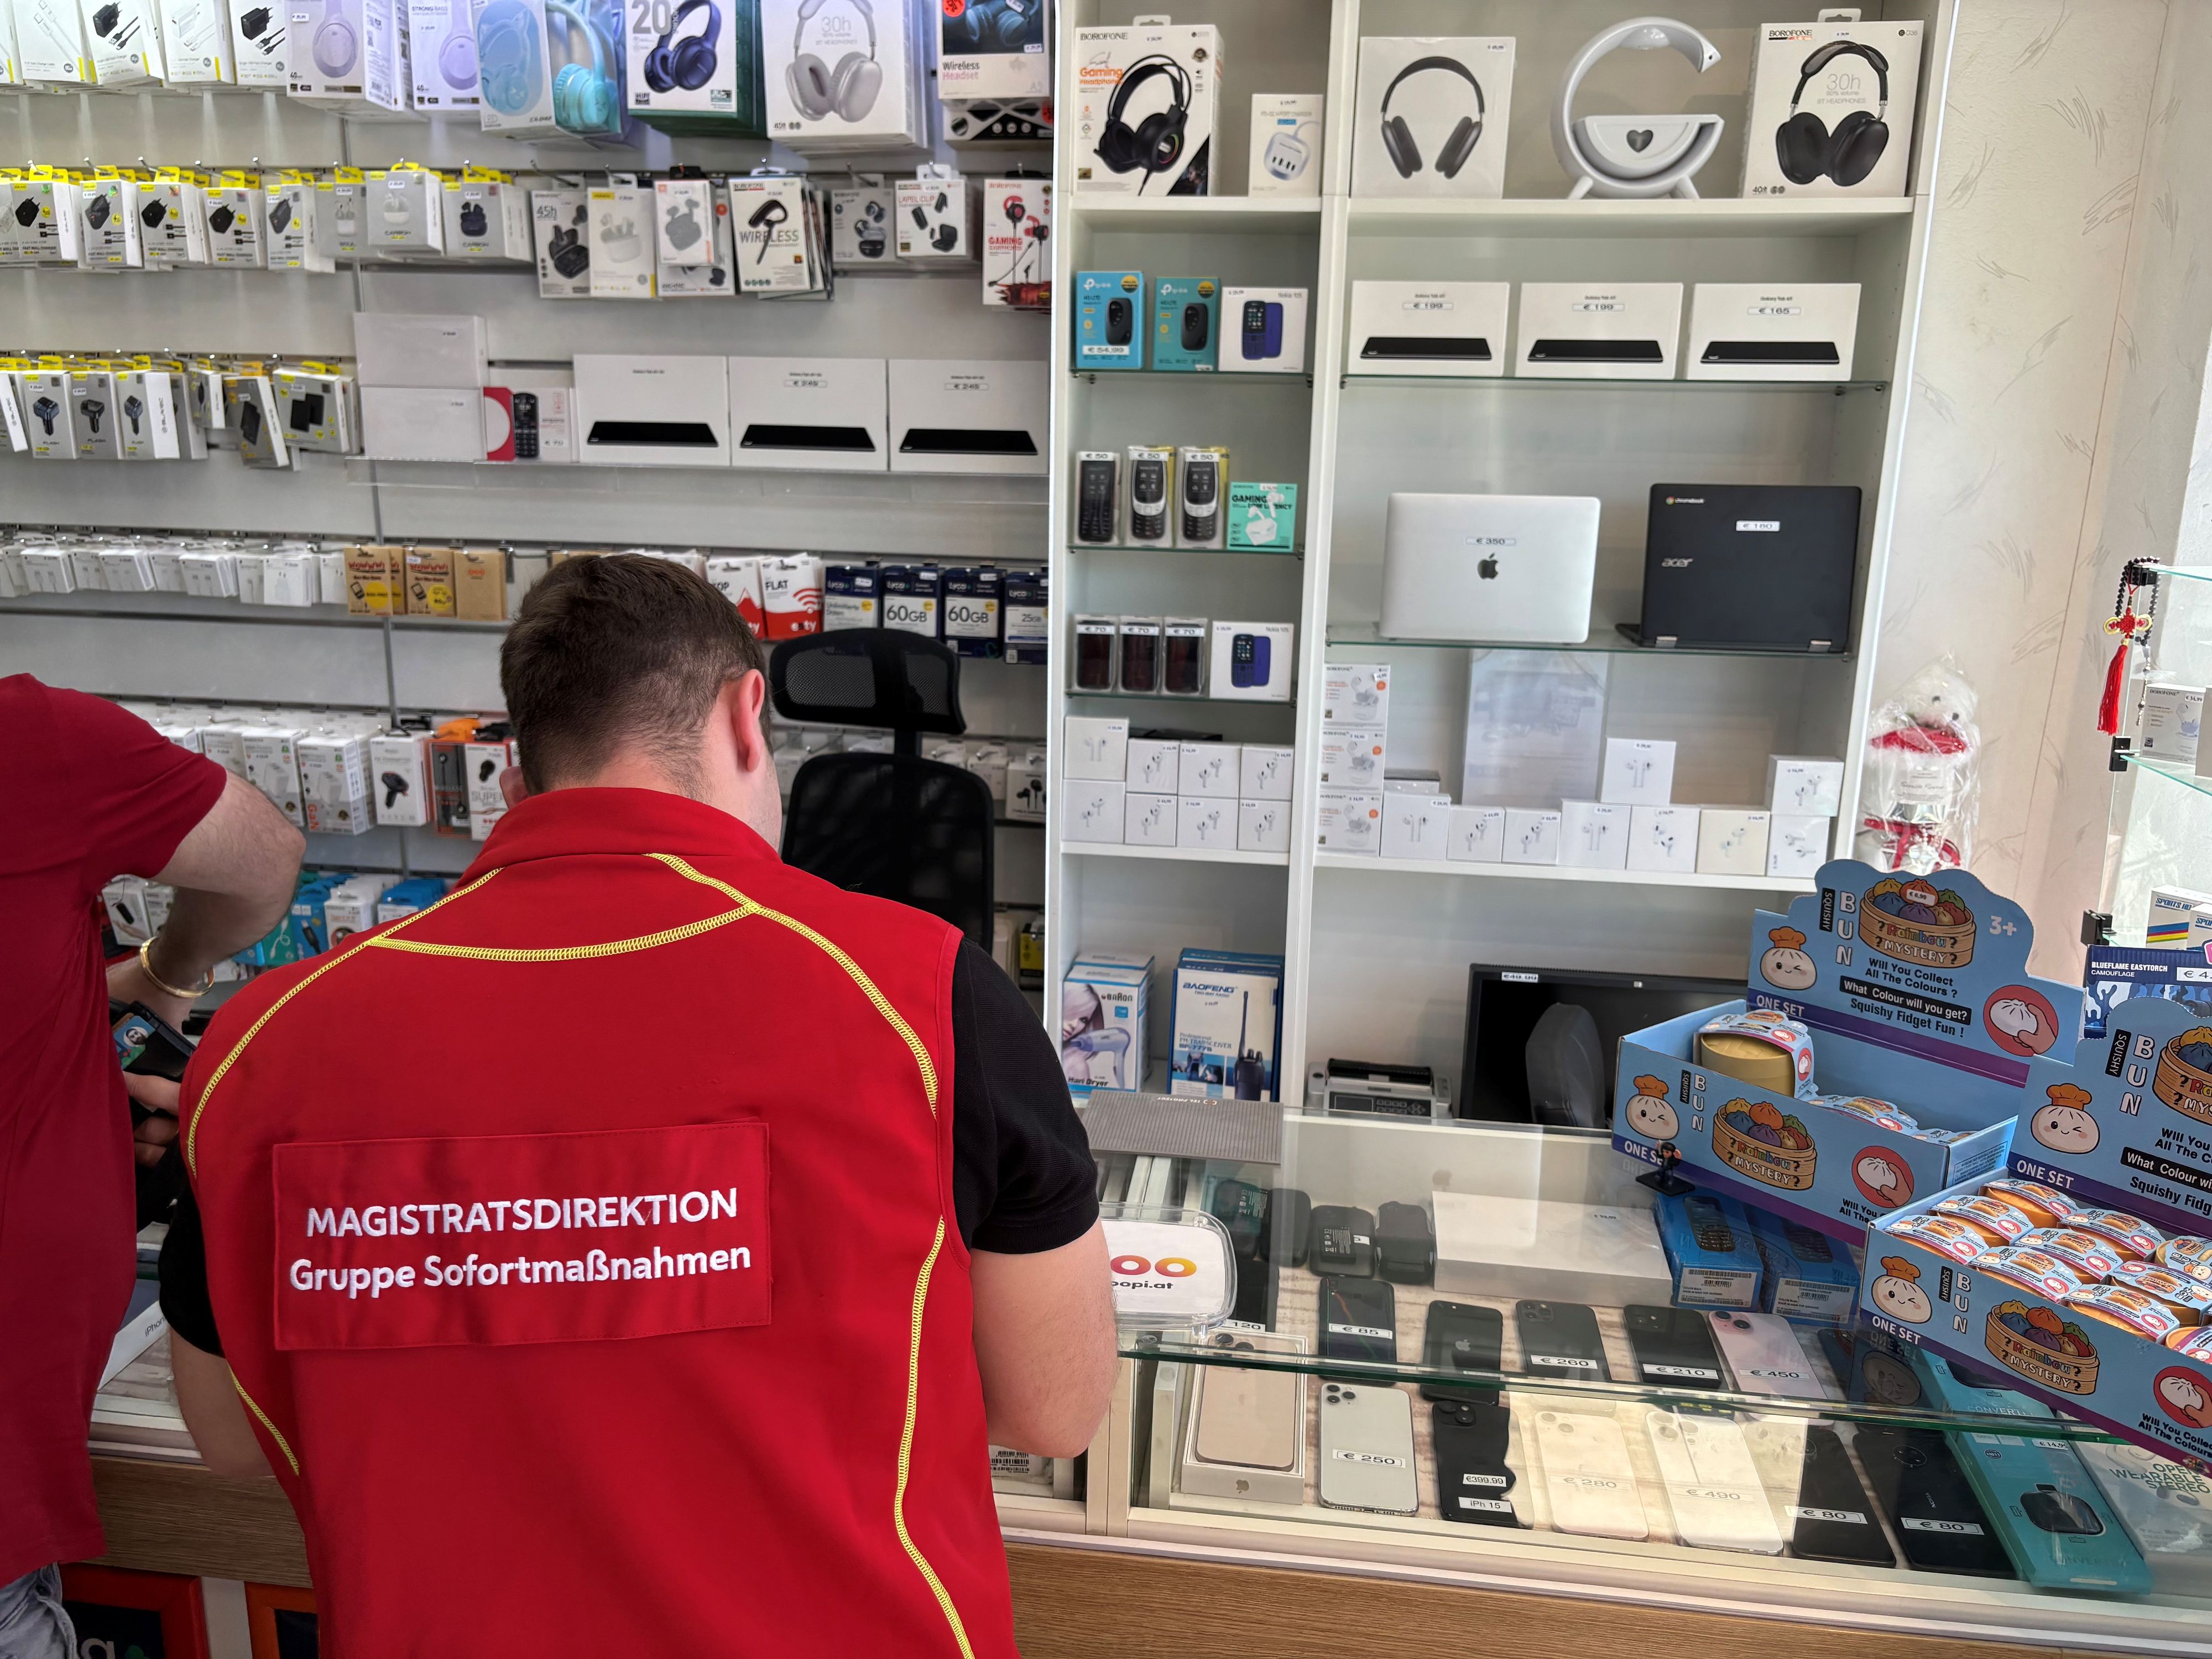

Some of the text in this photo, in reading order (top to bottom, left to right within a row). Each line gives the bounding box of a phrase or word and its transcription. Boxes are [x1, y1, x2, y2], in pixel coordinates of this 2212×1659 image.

[942, 61, 980, 70] Wireless
[1079, 67, 1123, 79] Gaming
[1827, 73, 1861, 91] 30h
[1662, 559, 1693, 567] acer
[713, 582, 729, 591] OP
[765, 581, 789, 591] FLAT
[886, 606, 927, 623] 60GB
[948, 606, 989, 623] 60GB
[1823, 891, 1832, 931] SQUISHY
[2156, 898, 2182, 909] SPORTS
[1887, 924, 1947, 947] Rainbow
[1989, 915, 2017, 936] 3+
[1884, 940, 1947, 963] MYSTERY
[1869, 957, 1953, 987] Will You Collect
[2091, 962, 2168, 972] BLUEFLAME EASYTORCH
[1183, 982, 1235, 993] BAOFENG
[1865, 968, 1879, 979] All
[1882, 972, 1901, 984] The
[1905, 977, 1948, 996] Colours
[1756, 995, 1804, 1019] ONE SET
[1844, 980, 1967, 1021] What Colour will you get?
[1851, 998, 1893, 1020] Squishy
[1896, 1009, 1932, 1030] Fidget
[1936, 1021, 1955, 1036] Fun
[1190, 1039, 1232, 1048] TRANSCEIVER
[2109, 1034, 2127, 1074] SQUISHY
[1681, 1073, 1689, 1103] SQUISHY
[2155, 1139, 2198, 1159] All The
[2162, 1128, 2211, 1151] Will You
[1624, 1141, 1648, 1159] ONE
[1737, 1142, 1791, 1171] Rainbow
[1735, 1156, 1791, 1185] MYSTERY
[2017, 1160, 2046, 1180] ONE
[2047, 1169, 2075, 1190] SET
[2127, 1152, 2198, 1184] What Colour
[2130, 1176, 2212, 1216] Squishy Fidg
[306, 1187, 738, 1238] MAGISTRATSDIREKTION
[1839, 1207, 1851, 1217] All
[1843, 1198, 1877, 1218] Will You
[289, 1245, 751, 1299] Gruppe Sofortmaßnahmen
[1942, 1269, 1951, 1301] SQUISHY
[144, 1317, 166, 1338] iPhon
[1233, 1321, 1263, 1331] 120
[1358, 1328, 1379, 1336] 85
[1872, 1316, 1921, 1345] ONE SET
[1556, 1359, 1589, 1368] 260
[2012, 1340, 2071, 1375] Rainbow
[1672, 1368, 1706, 1376] 210
[1767, 1370, 1800, 1379] 450
[2010, 1355, 2071, 1389] MYSTERY
[2138, 1421, 2151, 1432] All
[2154, 1427, 2172, 1441] The
[2142, 1413, 2212, 1451] Will You Collec
[1361, 1455, 1396, 1465] 250
[1465, 1475, 1504, 1484] €399.99
[1581, 1479, 1617, 1488] 280
[2109, 1468, 2206, 1485] WEARABLE
[2145, 1479, 2211, 1494] STEREO
[1705, 1491, 1741, 1501] 490
[1802, 1509, 1847, 1521] € 80
[1920, 1520, 1965, 1532] € 80
